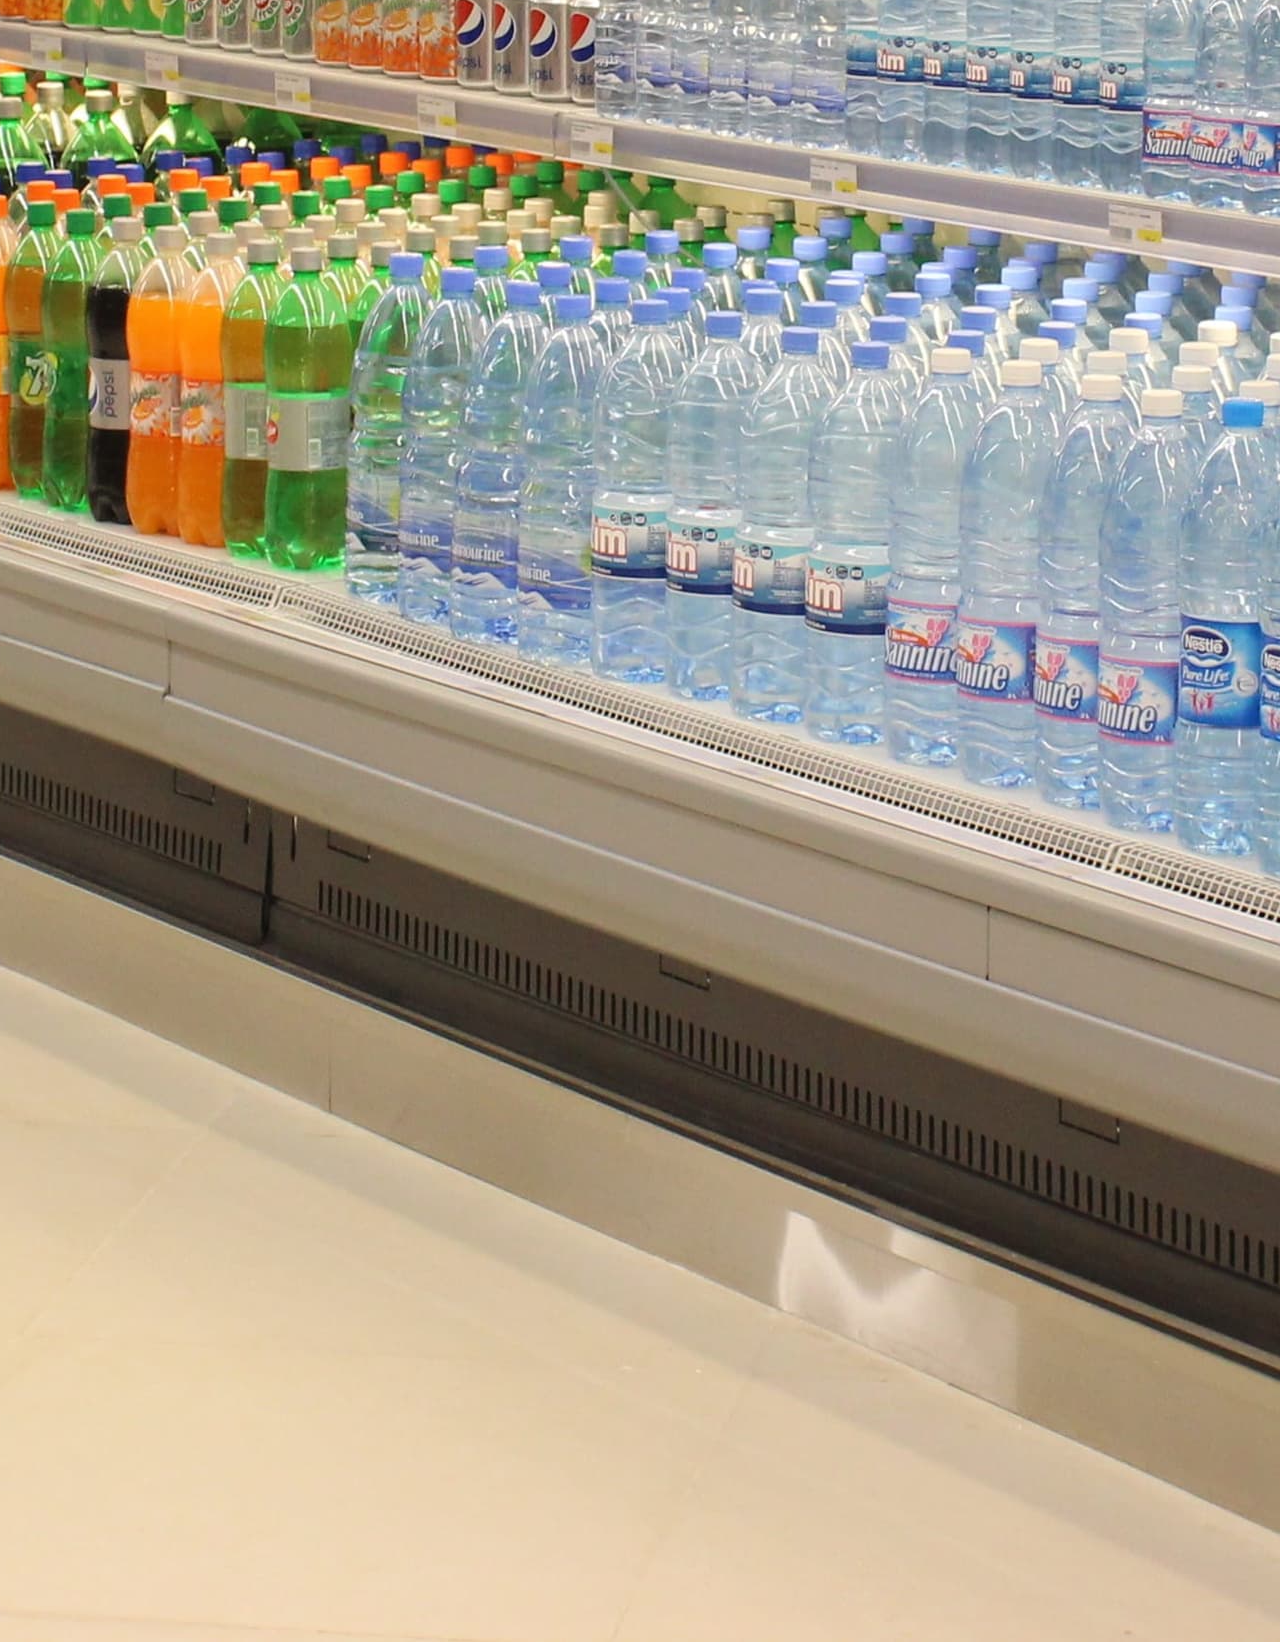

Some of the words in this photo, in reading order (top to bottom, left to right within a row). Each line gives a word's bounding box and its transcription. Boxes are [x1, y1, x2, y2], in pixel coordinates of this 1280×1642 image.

[1053, 70, 1072, 94] im
[1099, 75, 1118, 100] im
[103, 369, 119, 419] pepsi
[591, 515, 628, 558] im
[666, 529, 699, 573] im
[806, 566, 844, 613] im
[956, 660, 1011, 693] nnine
[1181, 664, 1205, 684] Pure
[1204, 667, 1230, 685] Life
[1262, 684, 1280, 703] Pure
[1098, 700, 1158, 735] nnine
